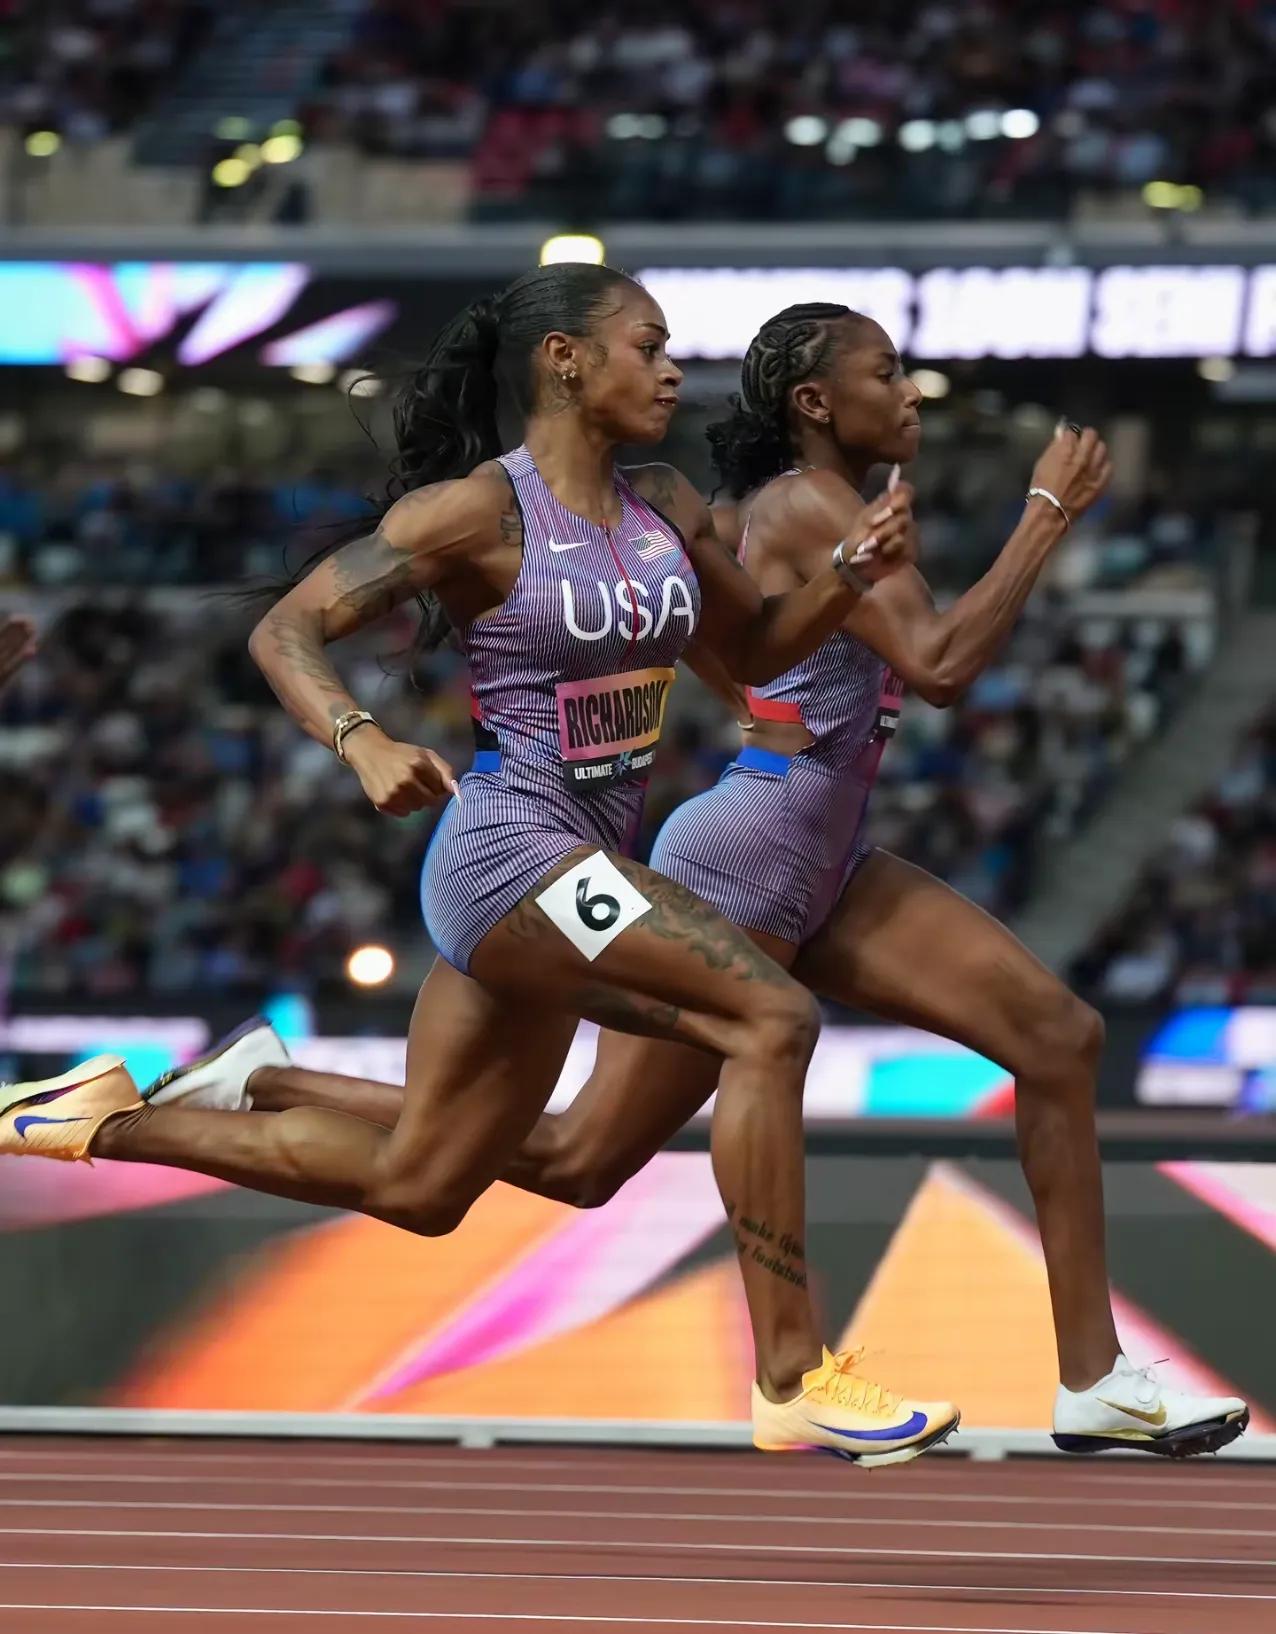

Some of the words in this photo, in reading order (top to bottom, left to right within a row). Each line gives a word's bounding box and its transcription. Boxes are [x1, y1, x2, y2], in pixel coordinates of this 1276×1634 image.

[561, 576, 694, 640] USA
[564, 680, 669, 749] RICHARDSON
[574, 763, 613, 780] ULTIMATE
[576, 876, 621, 932] 6
